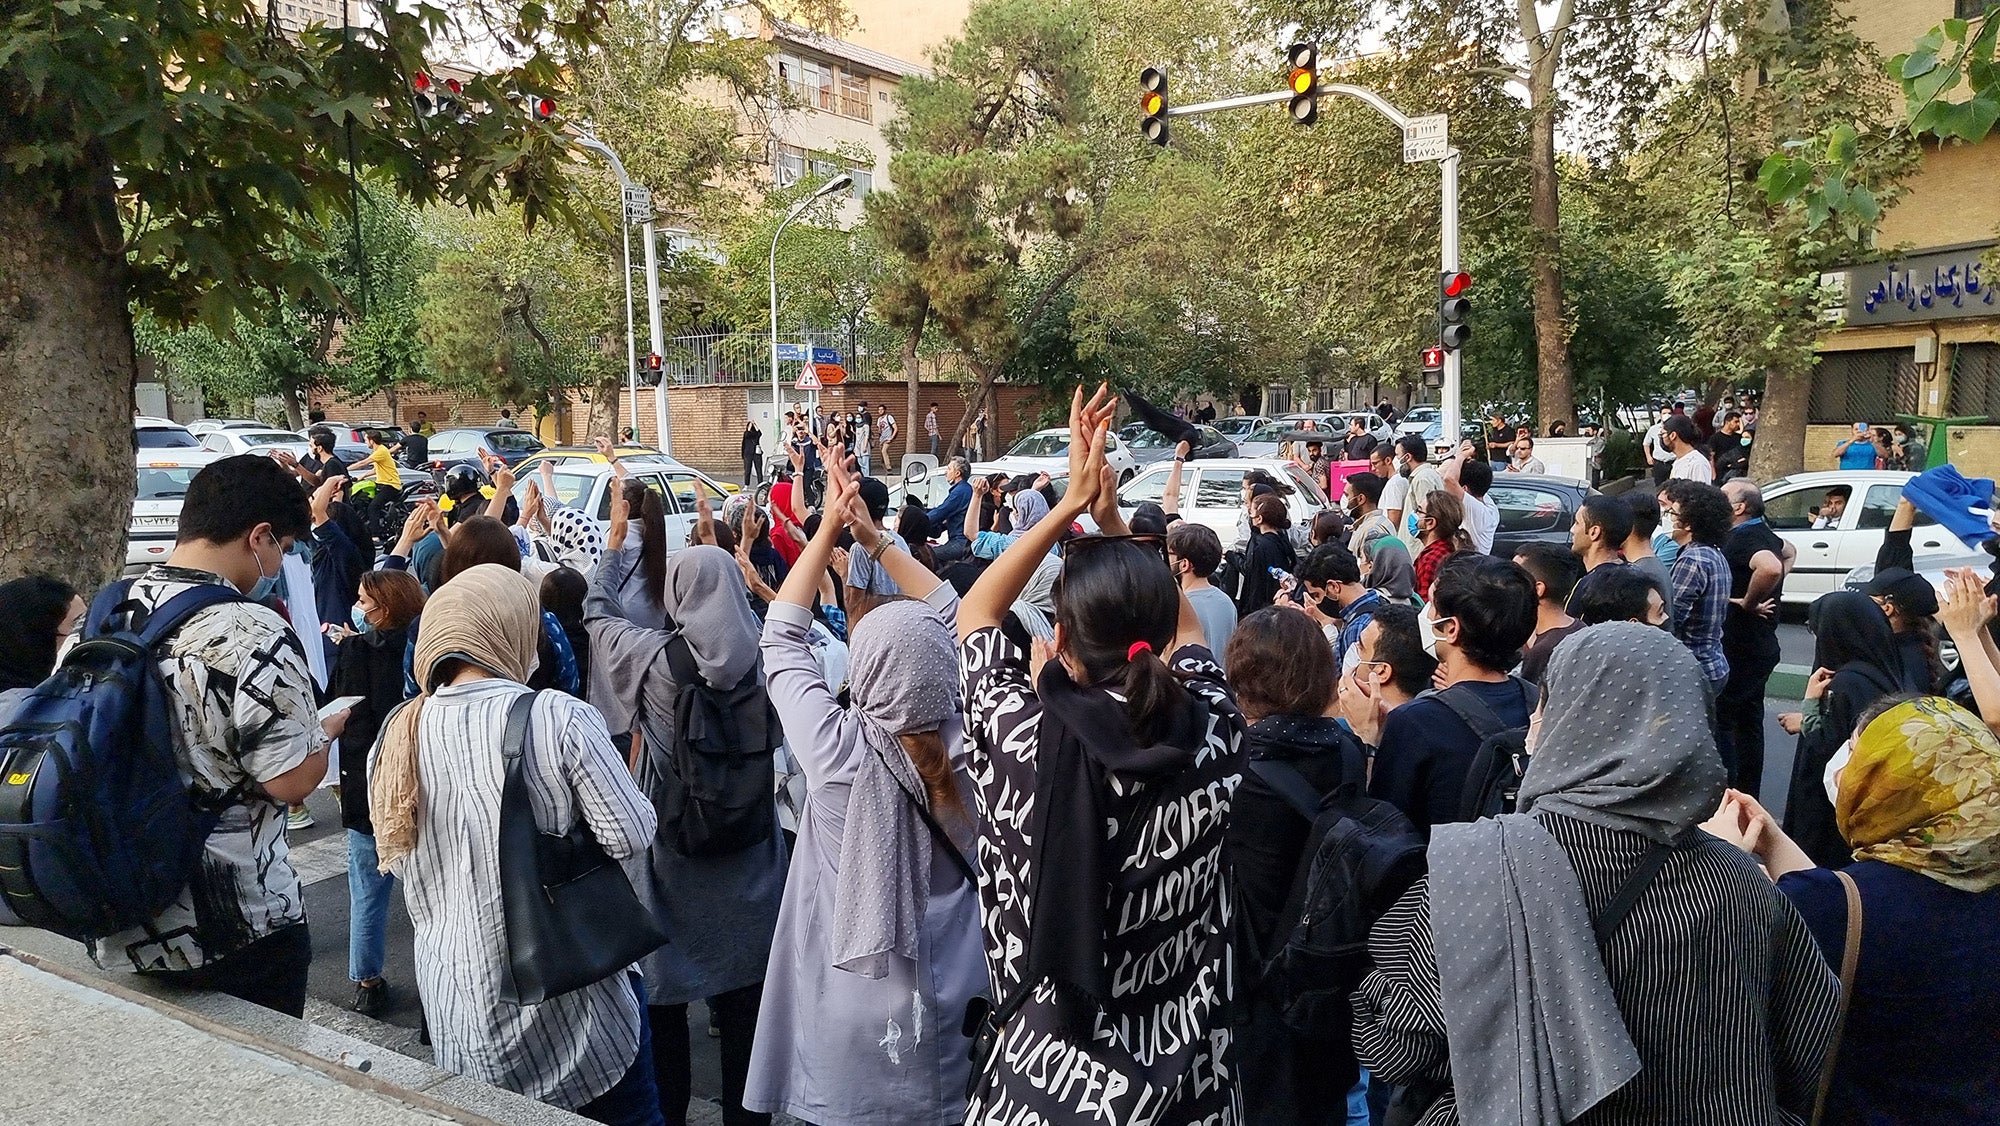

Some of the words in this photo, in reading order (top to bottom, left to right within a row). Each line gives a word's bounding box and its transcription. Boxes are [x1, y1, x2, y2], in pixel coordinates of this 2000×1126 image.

[1420, 124, 1439, 134] ۱۱۱۴
[1418, 148, 1444, 157] ۸۷۵۰۰
[1864, 263, 1895, 314] آهن
[1895, 270, 1916, 312] راه
[1005, 1014, 1129, 1126] LUSIFER
